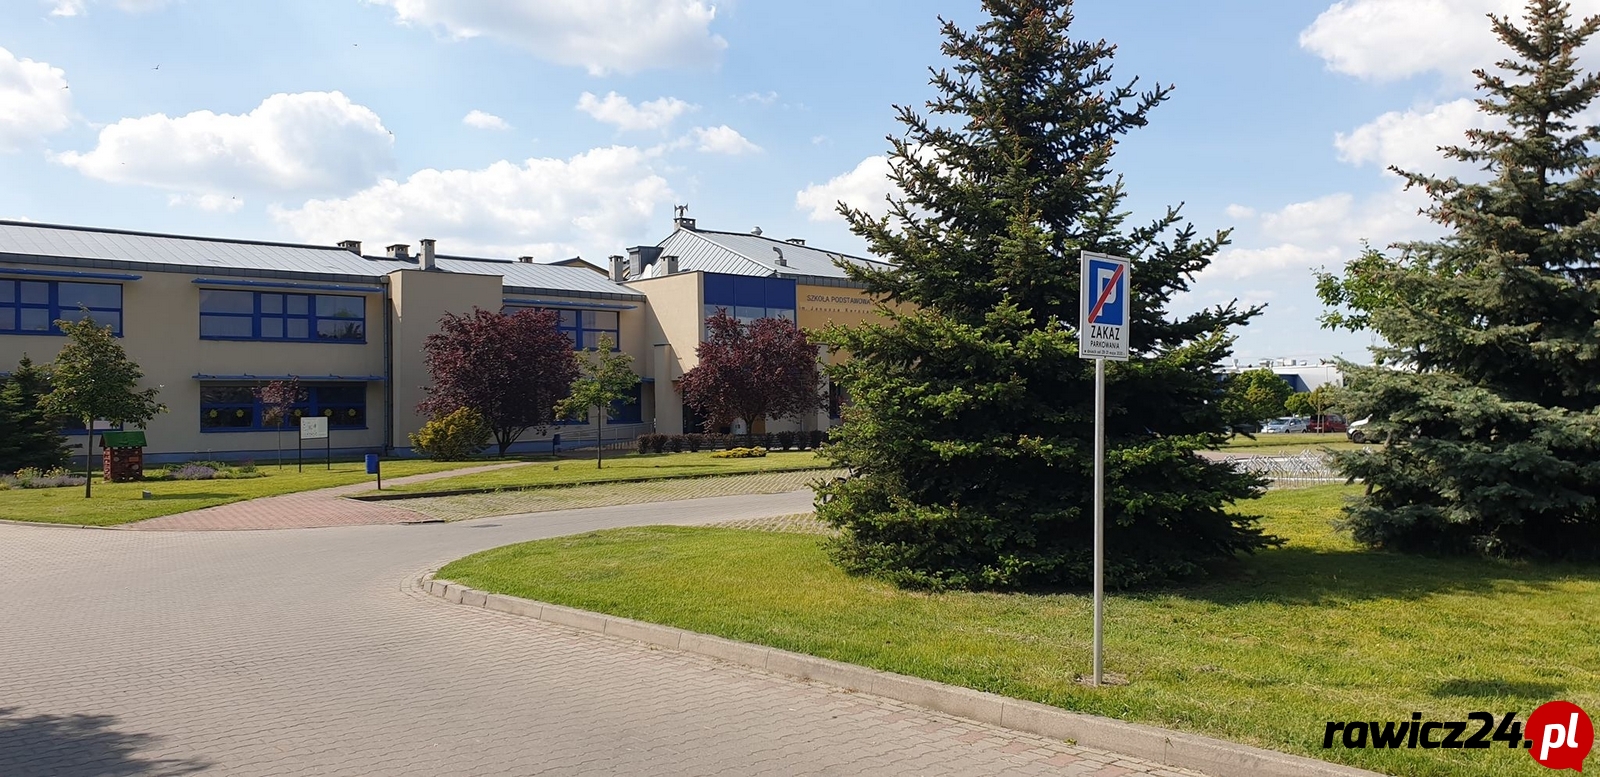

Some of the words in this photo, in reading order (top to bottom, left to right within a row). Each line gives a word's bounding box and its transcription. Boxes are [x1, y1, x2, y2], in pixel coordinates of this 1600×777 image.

[807, 294, 830, 303] SZKOŁA
[831, 296, 871, 305] PODSTAWOWA
[1091, 325, 1120, 341] ZAKAZ
[1090, 340, 1120, 350] PARKOWANIA
